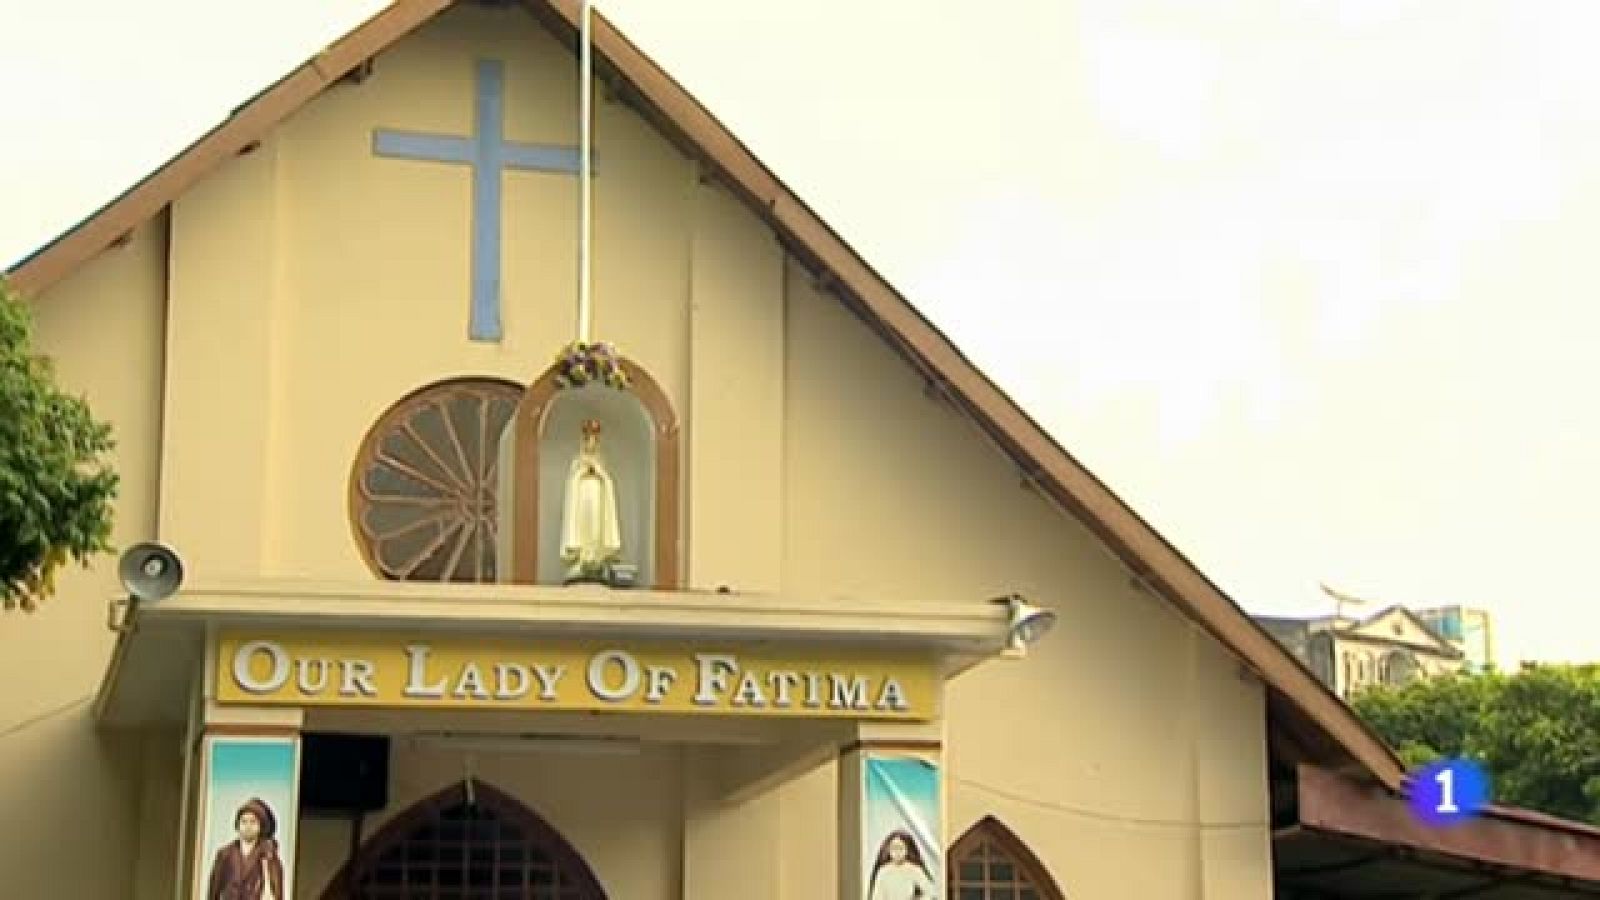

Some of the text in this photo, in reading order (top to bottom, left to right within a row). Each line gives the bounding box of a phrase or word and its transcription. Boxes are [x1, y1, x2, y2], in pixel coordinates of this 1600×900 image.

[232, 641, 908, 711] OUR LADY OF FATIMA
